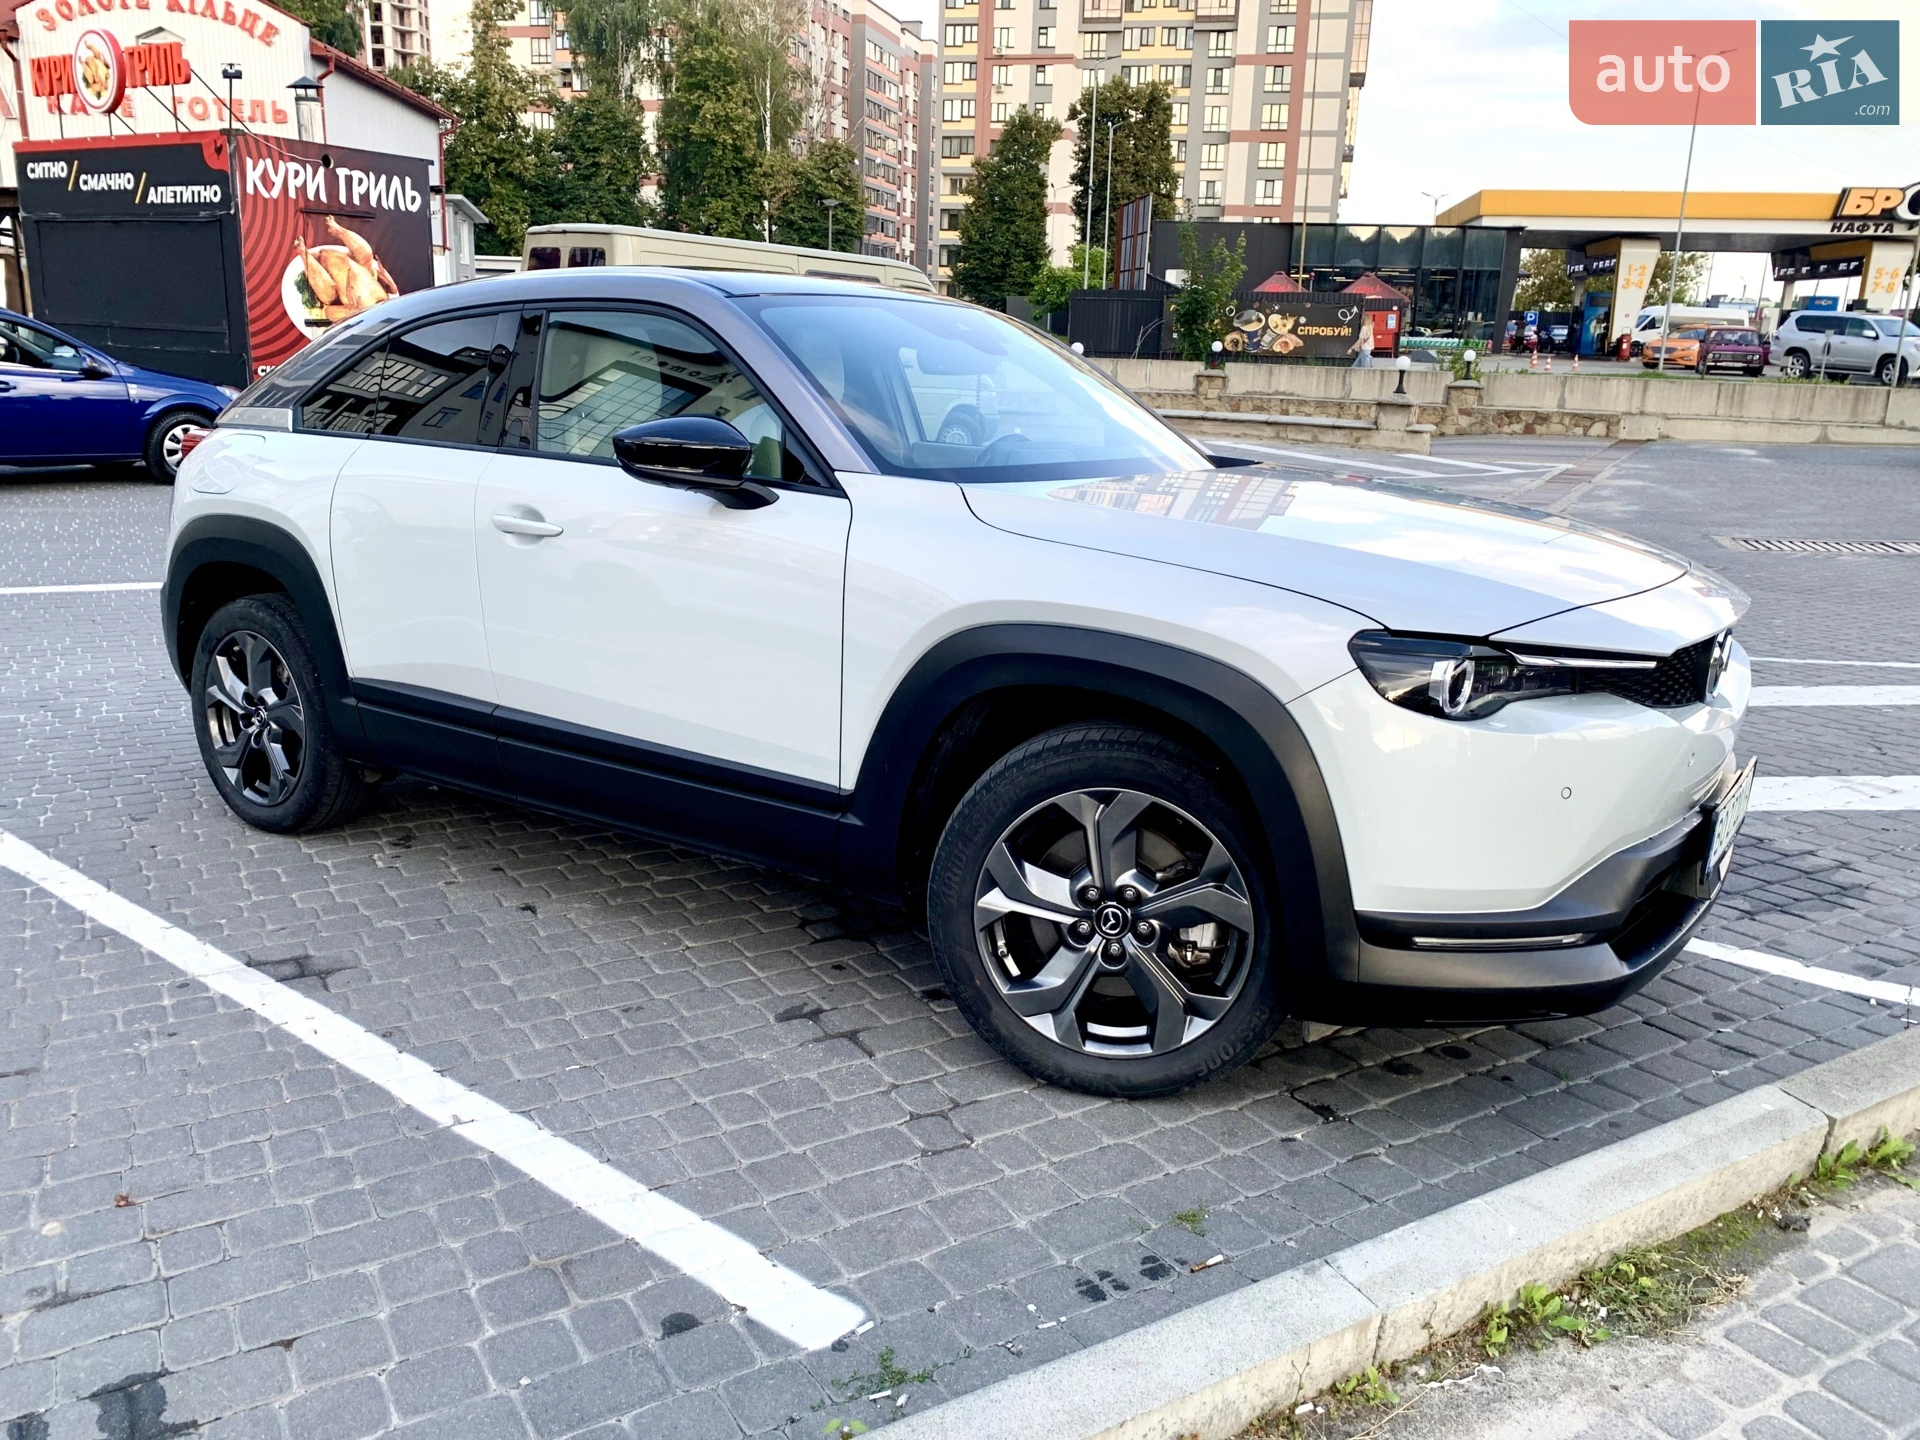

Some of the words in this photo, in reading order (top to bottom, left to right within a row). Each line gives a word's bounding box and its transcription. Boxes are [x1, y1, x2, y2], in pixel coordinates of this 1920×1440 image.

[29, 53, 78, 97] КУРИ
[124, 41, 192, 89] ГРИЛЬ
[46, 94, 136, 117] КАЕ
[171, 95, 288, 124] ГОТЕЛЬ
[26, 160, 68, 179] СИТНО
[78, 172, 135, 191] СМАЧНО
[146, 184, 222, 204] АПЕТИТНО
[245, 156, 328, 204] КУРИ
[335, 167, 422, 213] ГРИЛЬ
[1830, 222, 1894, 234] НАФТА
[1297, 325, 1352, 337] СПРОБУЙ!
